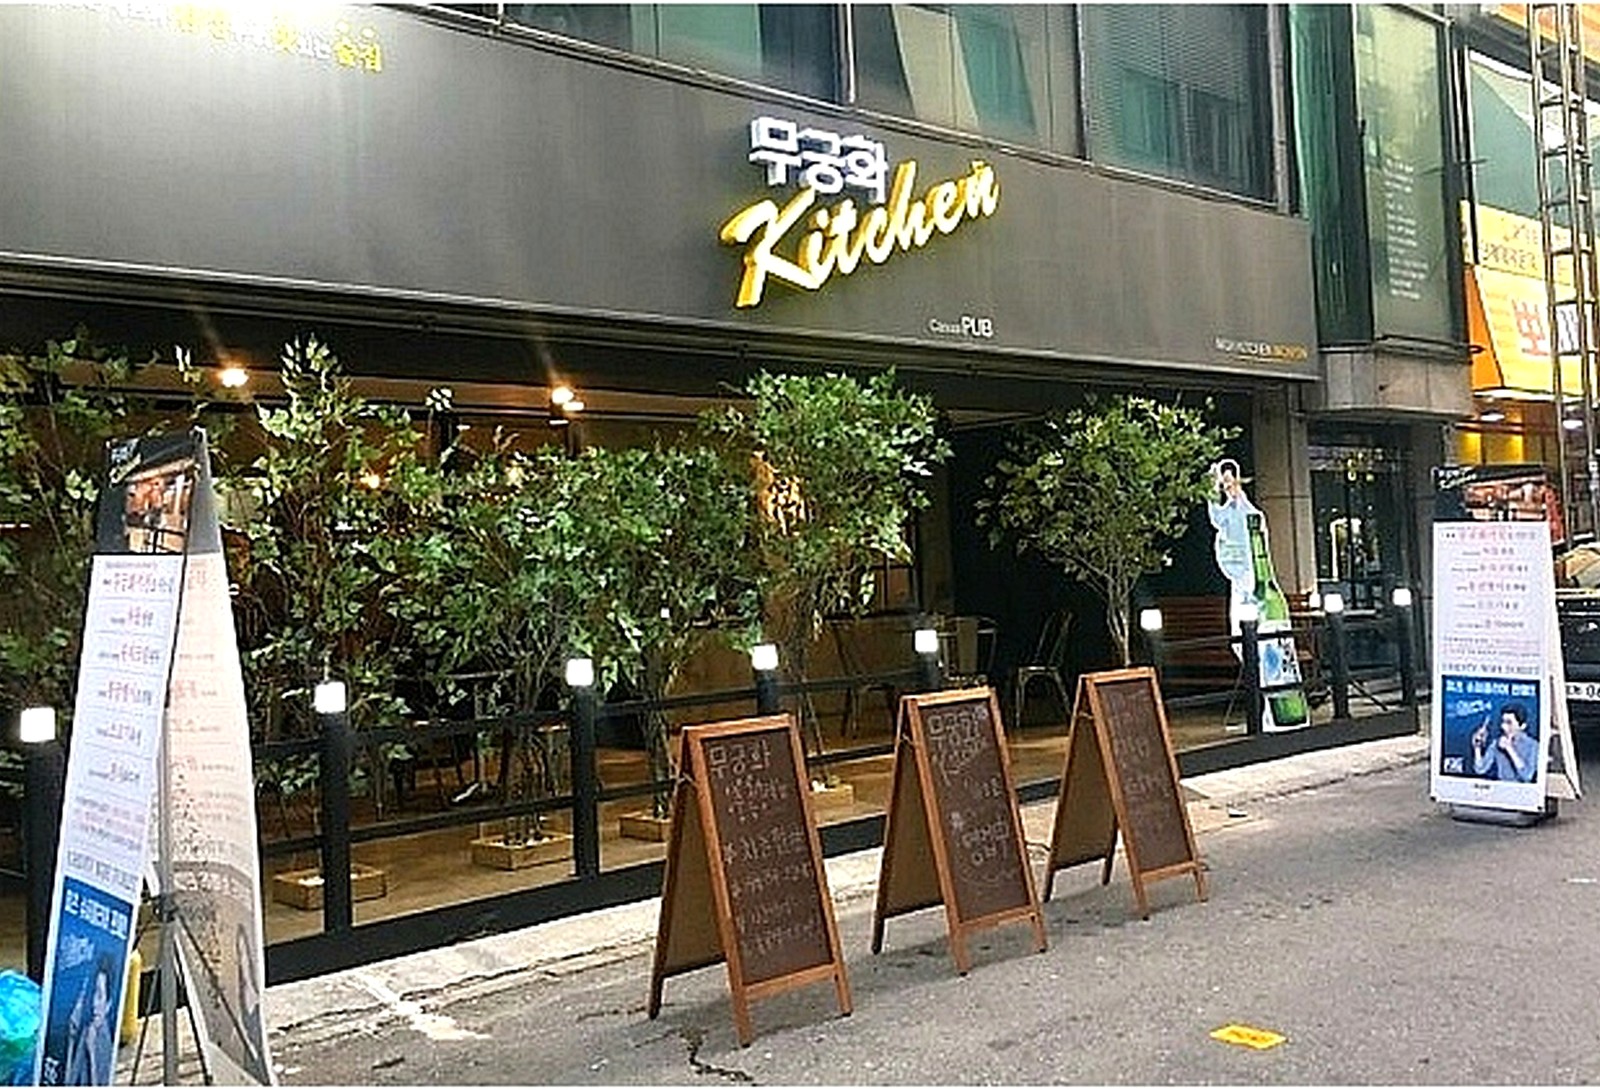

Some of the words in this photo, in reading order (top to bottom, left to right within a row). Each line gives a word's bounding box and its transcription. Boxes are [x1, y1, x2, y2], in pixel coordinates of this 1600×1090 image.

[749, 116, 888, 203] 무궁화
[719, 160, 999, 308] Kitchen
[961, 316, 994, 337] PUB
